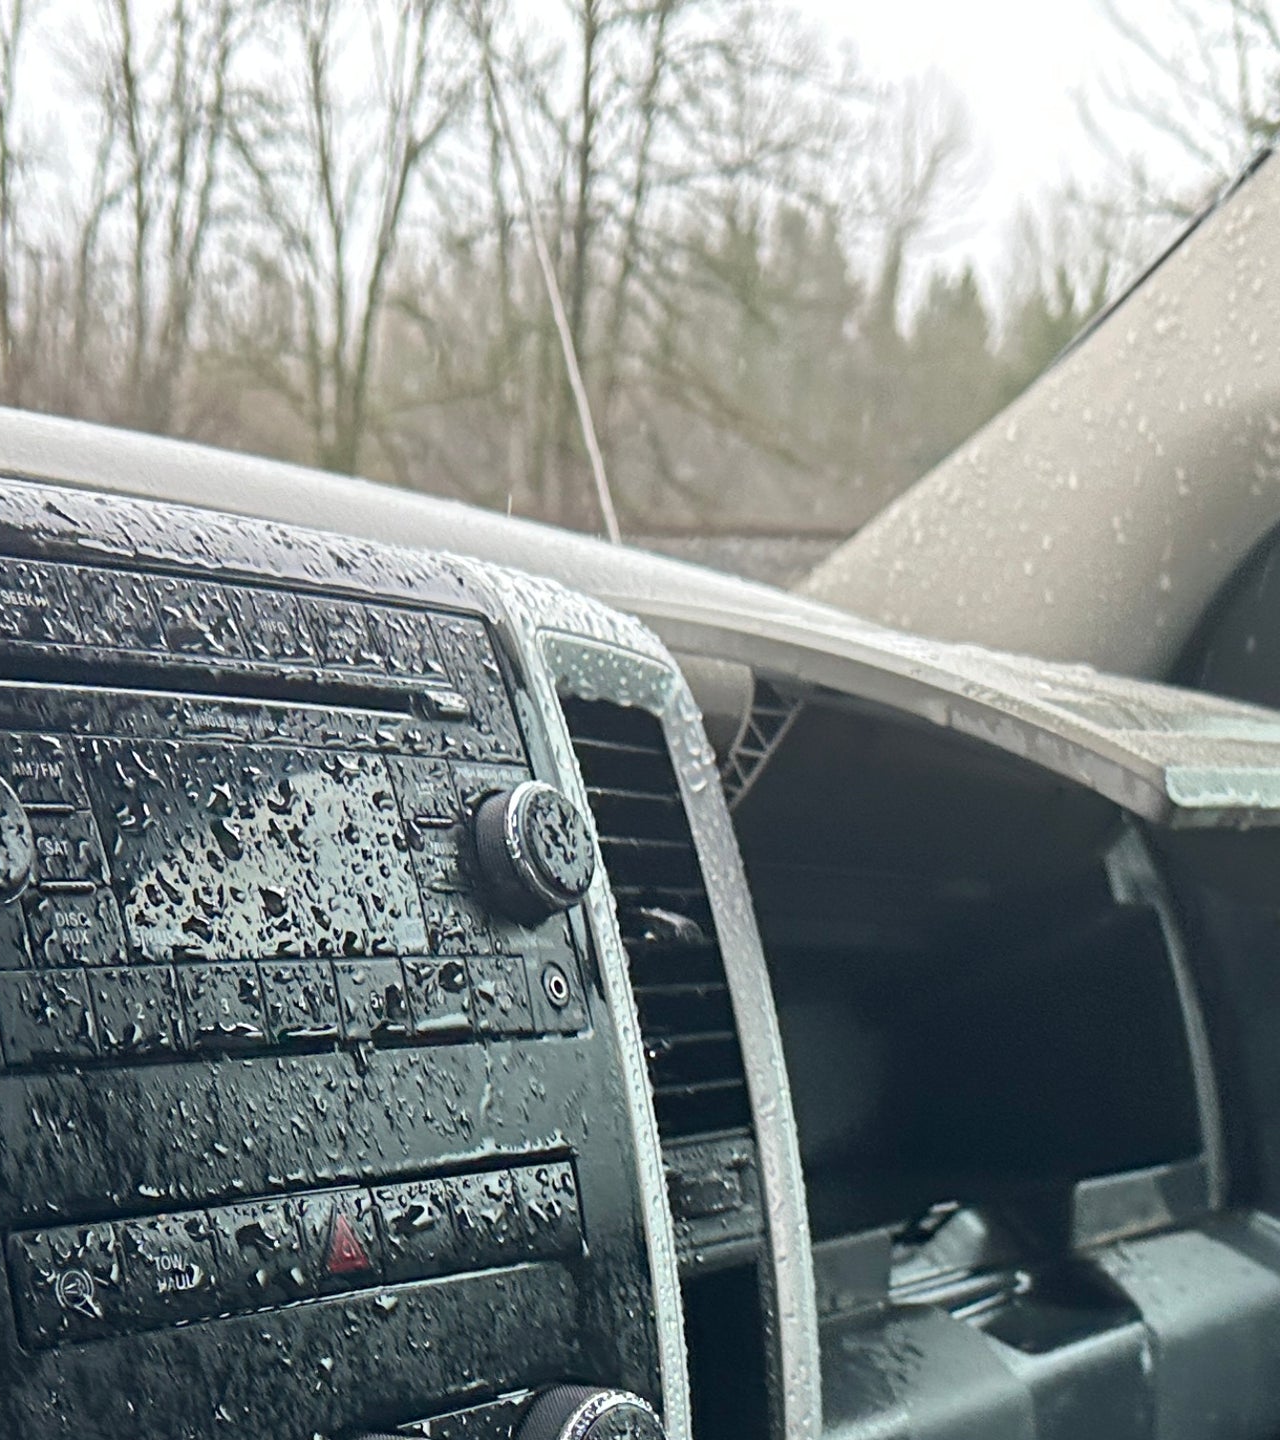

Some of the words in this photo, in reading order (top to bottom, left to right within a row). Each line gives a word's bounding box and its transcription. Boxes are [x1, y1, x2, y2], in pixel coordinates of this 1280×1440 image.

[0, 589, 34, 607] SEEK
[11, 762, 62, 778] AM/FM
[44, 840, 69, 855] SAT
[56, 912, 90, 927] DISC
[62, 929, 90, 945] AUX
[136, 1002, 146, 1020] 2
[221, 998, 231, 1015] 3
[157, 1272, 196, 1293] HAUL
